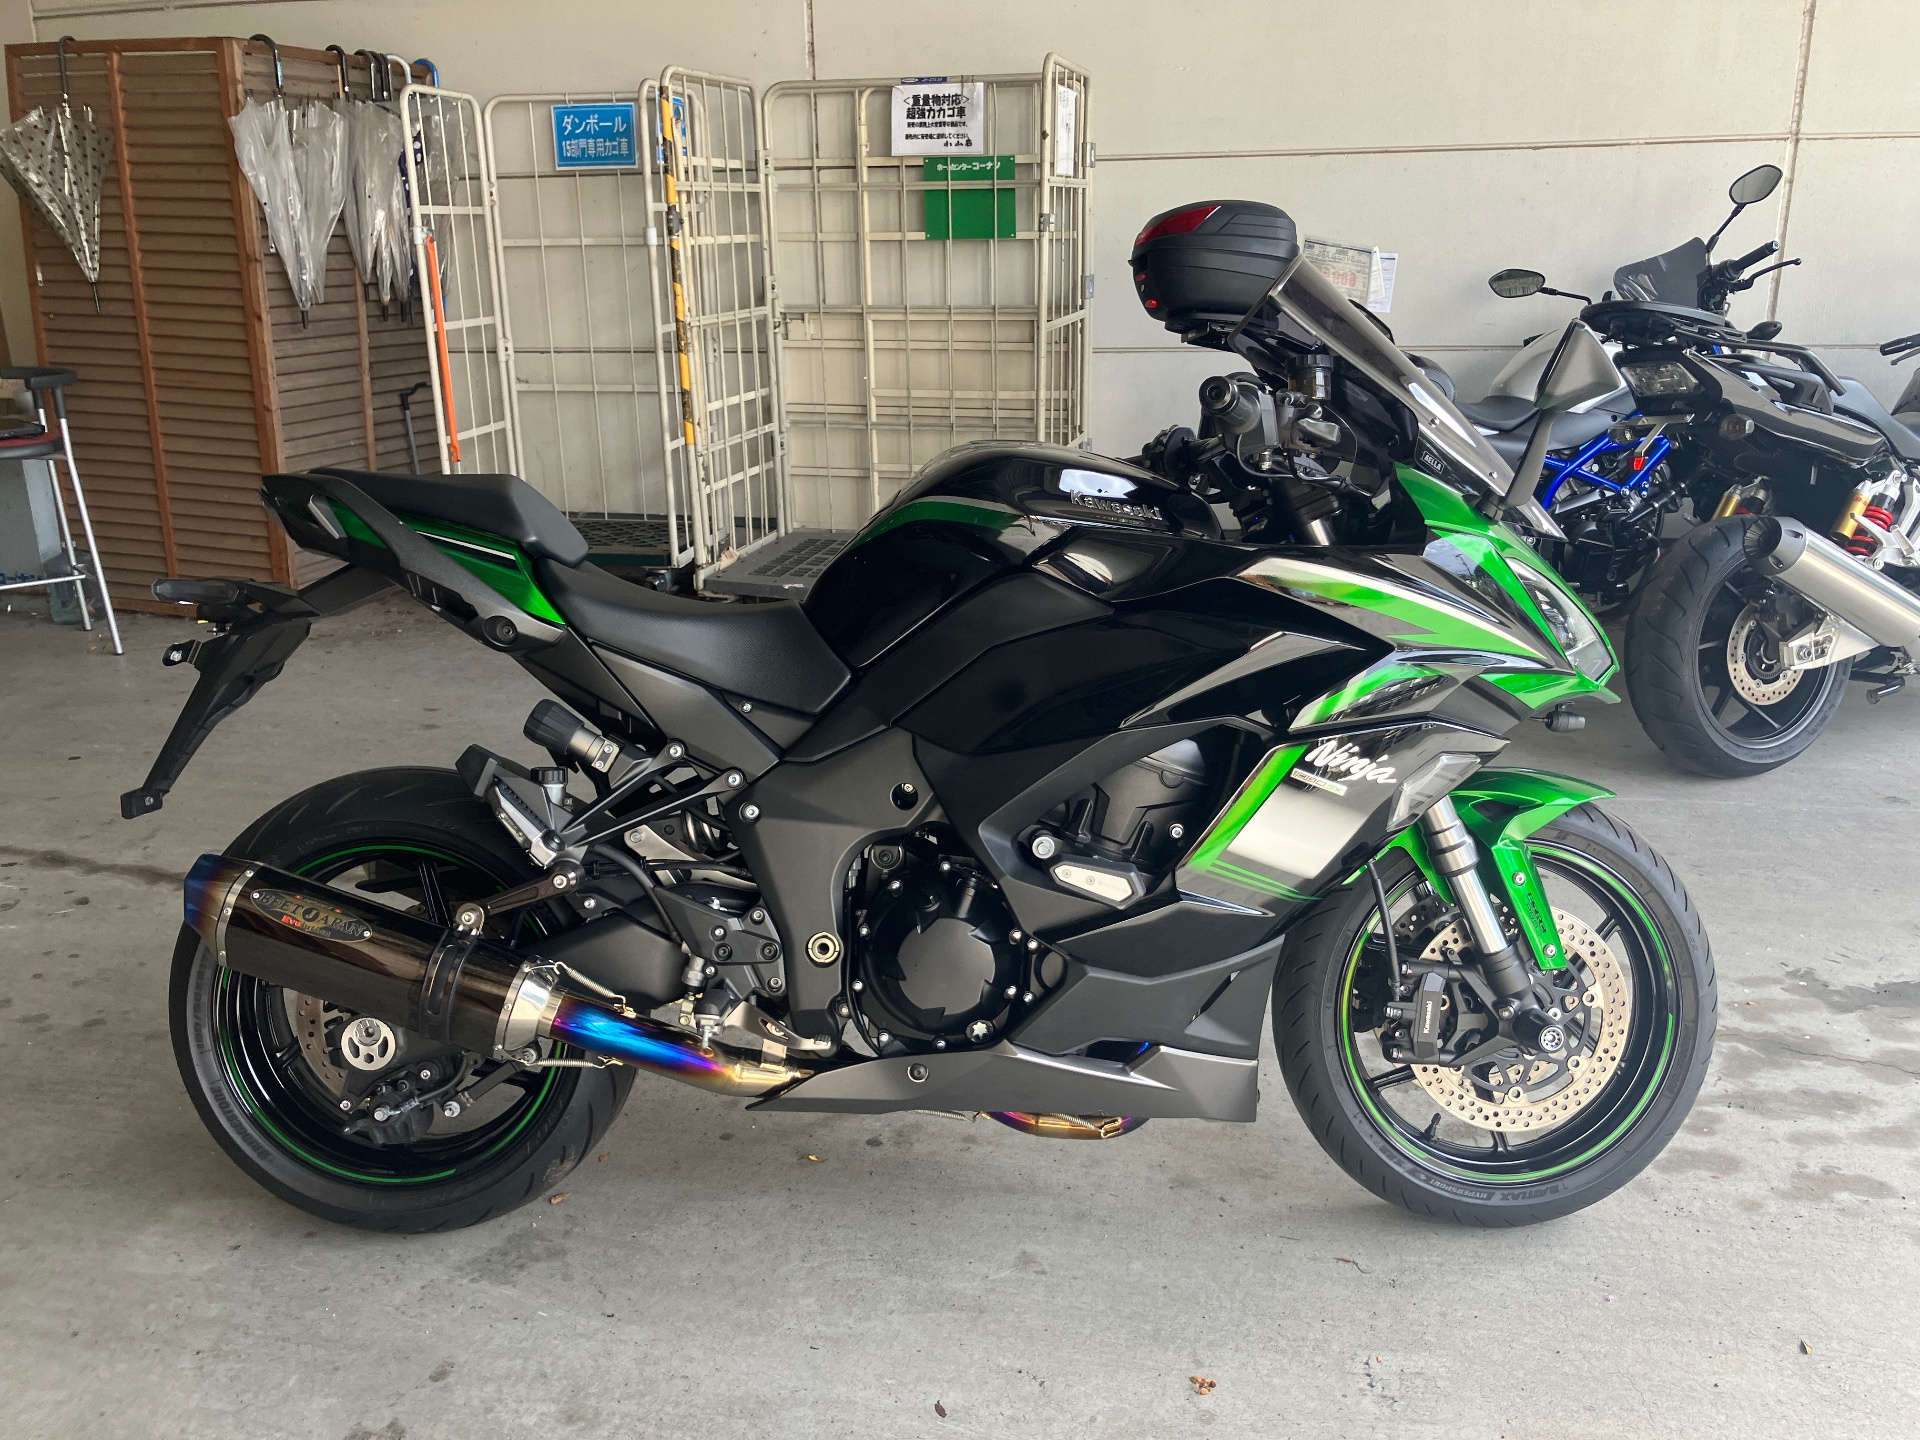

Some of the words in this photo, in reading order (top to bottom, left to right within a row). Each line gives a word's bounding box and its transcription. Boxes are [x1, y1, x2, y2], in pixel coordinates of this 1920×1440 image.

[562, 114, 627, 135] ダンボール
[906, 106, 966, 119] 超強力カゴ車
[562, 137, 629, 158] 15部門専用カゴ車
[1070, 489, 1162, 520] Kawasaki
[1305, 740, 1397, 783] Ninja
[305, 908, 367, 937] JAPAN
[1422, 1001, 1433, 1034] Kawasaki
[1428, 1178, 1488, 1200] HYPERSPORT
